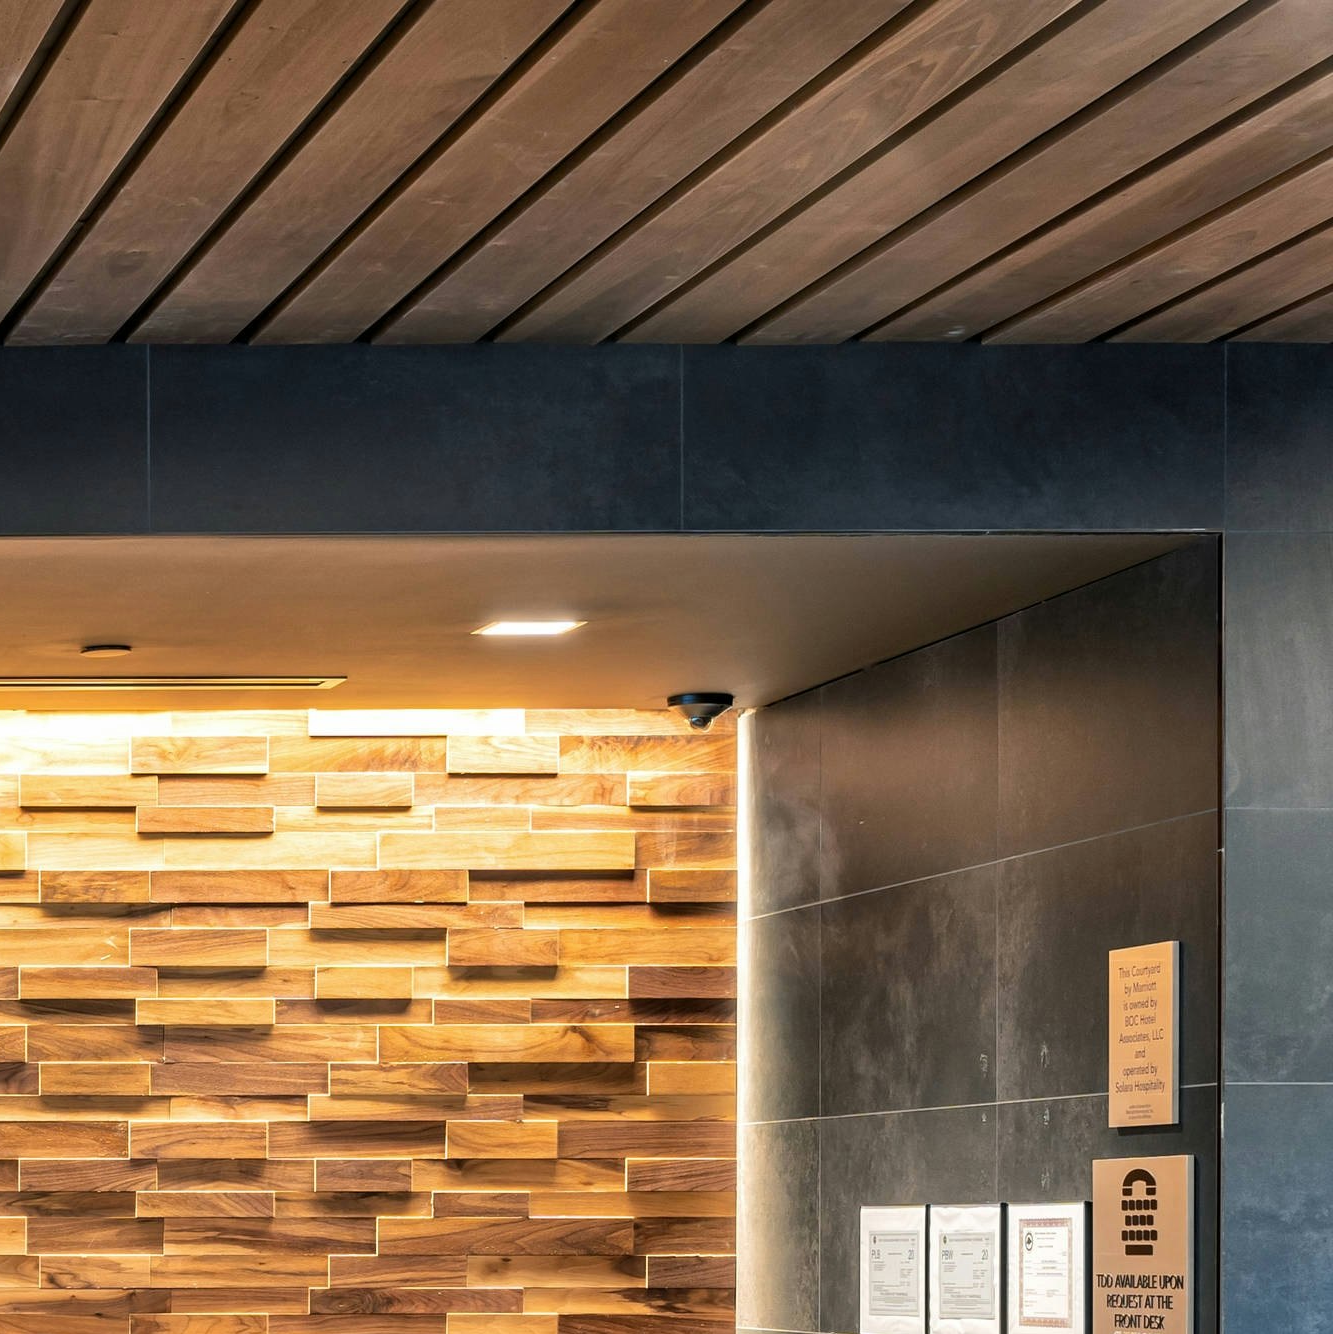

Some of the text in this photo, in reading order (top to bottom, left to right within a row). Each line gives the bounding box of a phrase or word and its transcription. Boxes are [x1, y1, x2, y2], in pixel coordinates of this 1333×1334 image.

[1118, 963, 1161, 978] This Courtyard
[1124, 982, 1157, 996] by Marriott
[1129, 998, 1149, 1010] owned
[1150, 997, 1157, 1010] by
[1140, 1013, 1157, 1025] Hotel
[1152, 1028, 1164, 1041] LLC
[1134, 1047, 1146, 1059] and
[1123, 1063, 1158, 1079] operated by
[1134, 1080, 1166, 1095] Hospitality
[981, 1249, 989, 1261] 20
[1096, 1274, 1184, 1290] TDD AVAILABLE UPON
[1106, 1294, 1174, 1310] REQUEST AT THE
[1114, 1313, 1165, 1330] FRONT DESK
